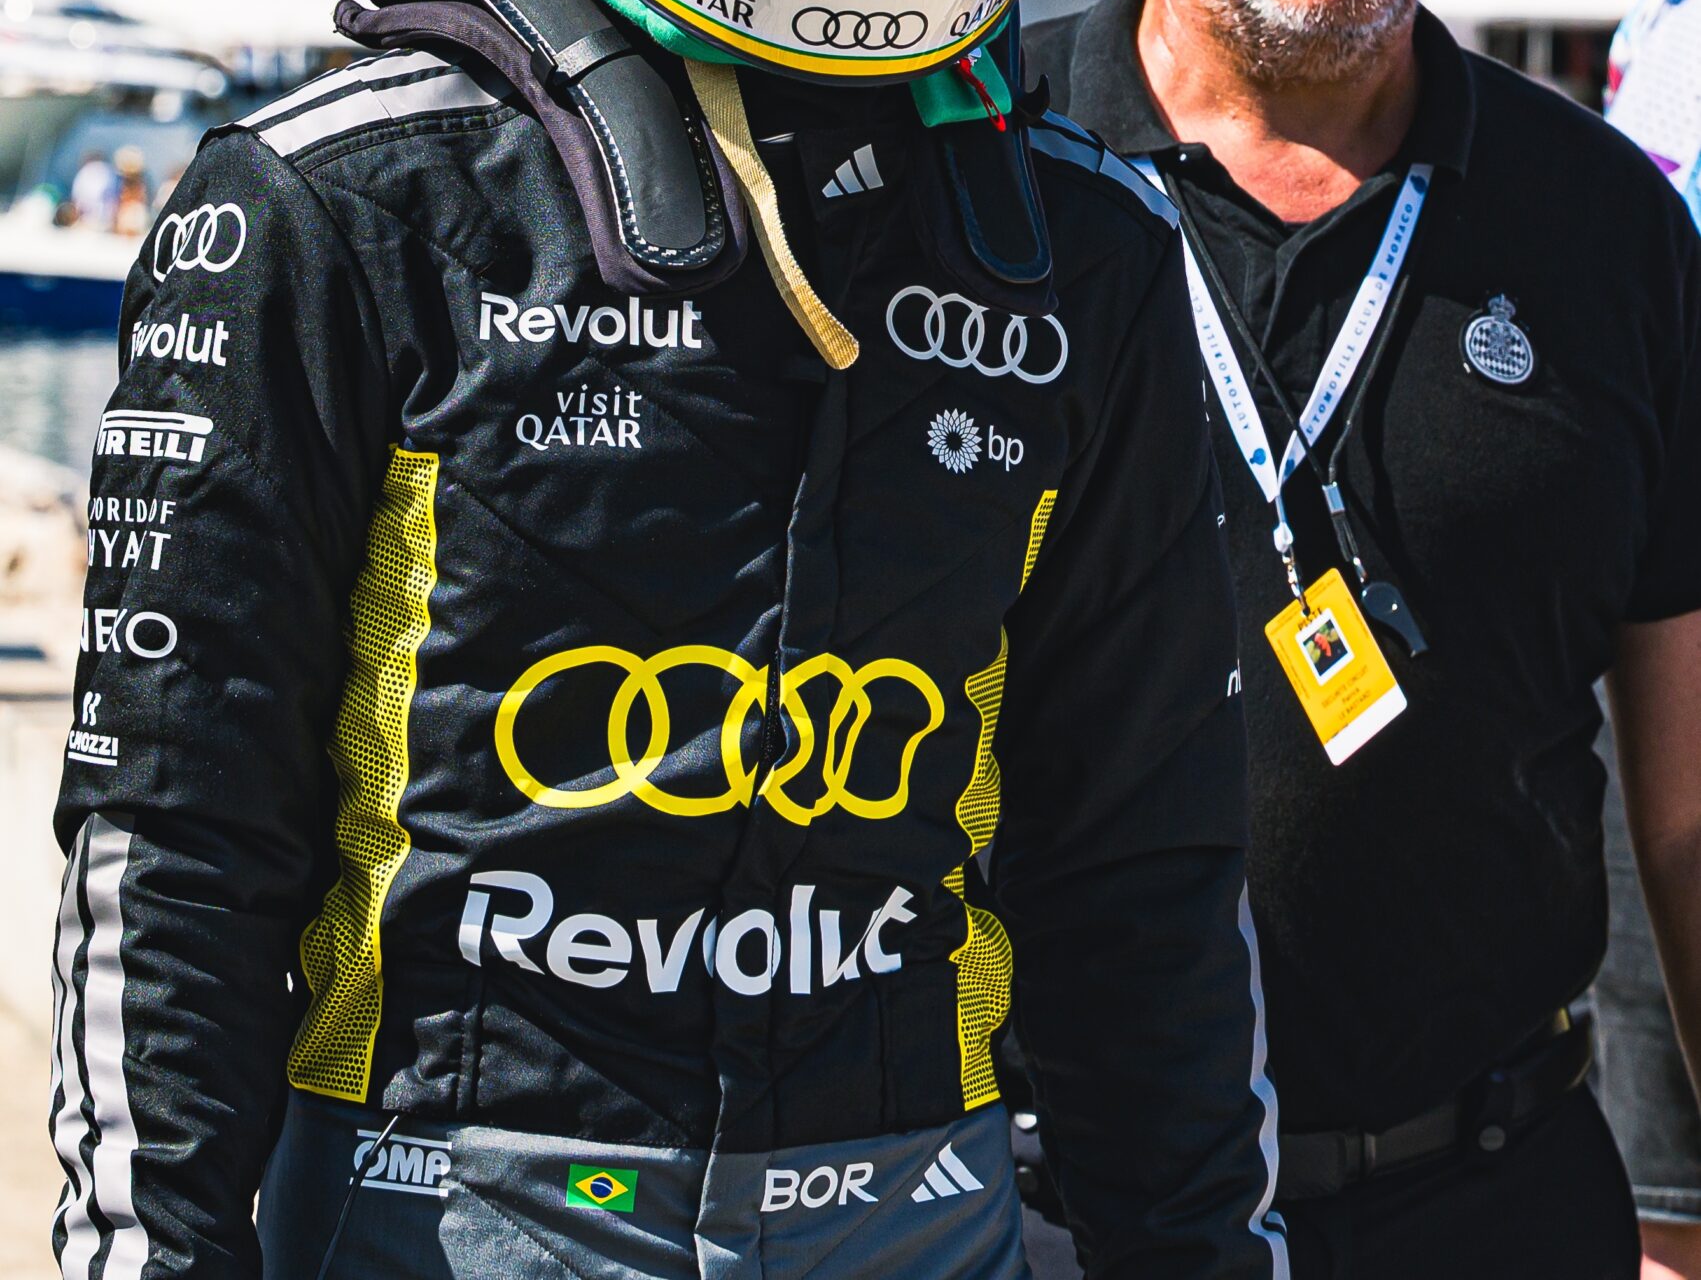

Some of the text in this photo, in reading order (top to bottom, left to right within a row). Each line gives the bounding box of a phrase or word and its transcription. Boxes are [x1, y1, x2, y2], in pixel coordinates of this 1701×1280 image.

[479, 291, 702, 349] Revolut
[557, 383, 642, 418] visit
[516, 413, 642, 450] QATAR
[988, 425, 1024, 472] bp
[458, 870, 917, 995] Revolut
[353, 1140, 451, 1186] OMP
[760, 1162, 879, 1212] BOR
